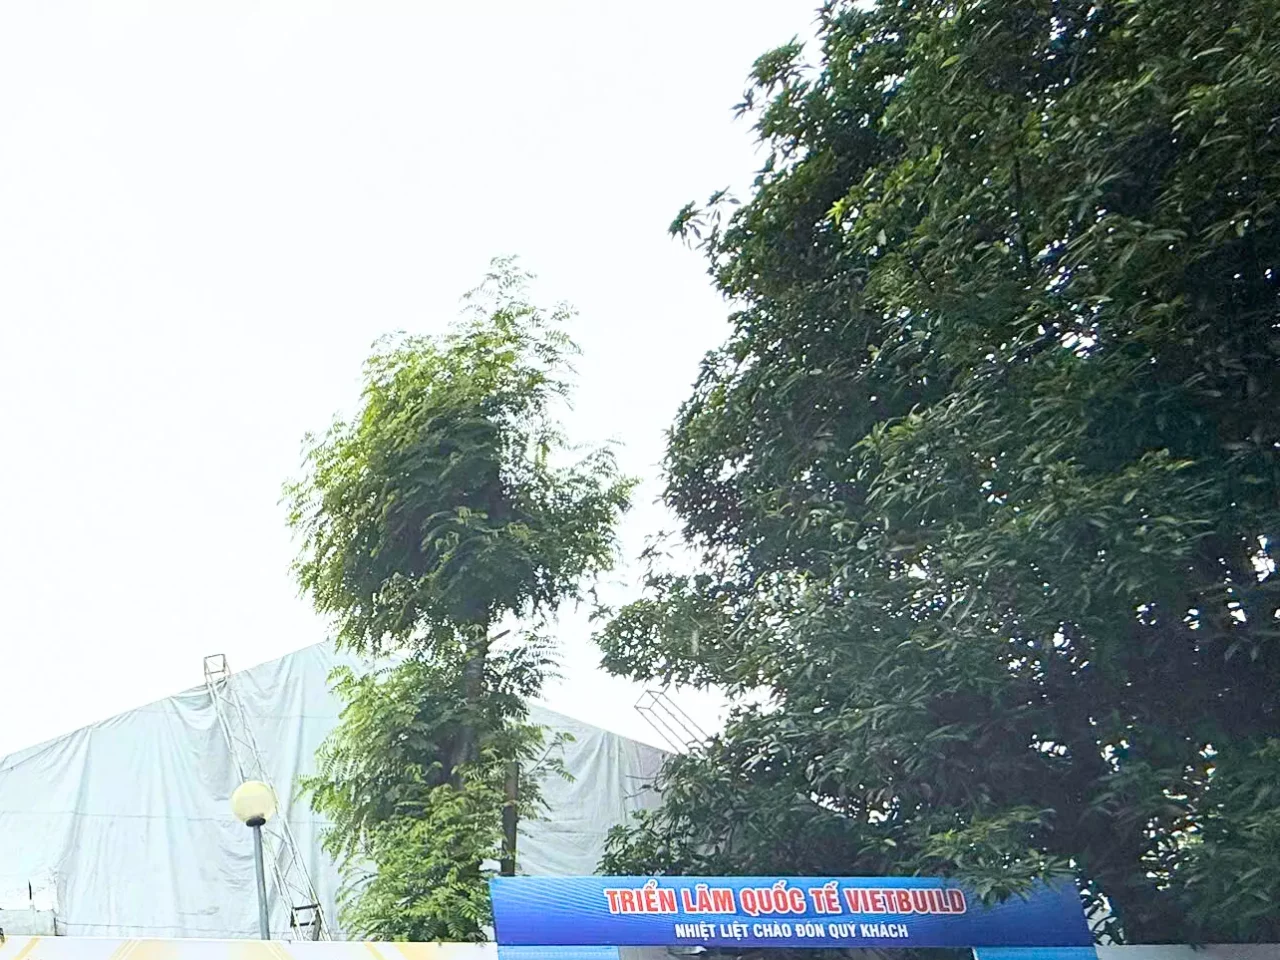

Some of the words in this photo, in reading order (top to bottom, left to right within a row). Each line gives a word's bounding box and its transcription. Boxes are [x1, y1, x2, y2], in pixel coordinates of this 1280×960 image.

[605, 880, 677, 913] TRIỂN
[682, 884, 735, 914] LÃM
[740, 880, 806, 915] QUỐC
[810, 881, 842, 914] TẾ
[844, 888, 966, 914] VIETBUILD
[675, 921, 716, 941] NHIỆT
[720, 921, 749, 941] LIỆT
[753, 921, 792, 938] CHÀO
[795, 921, 825, 938] ĐÓN
[829, 921, 856, 939] QUÝ
[860, 921, 908, 938] KHÁCH
